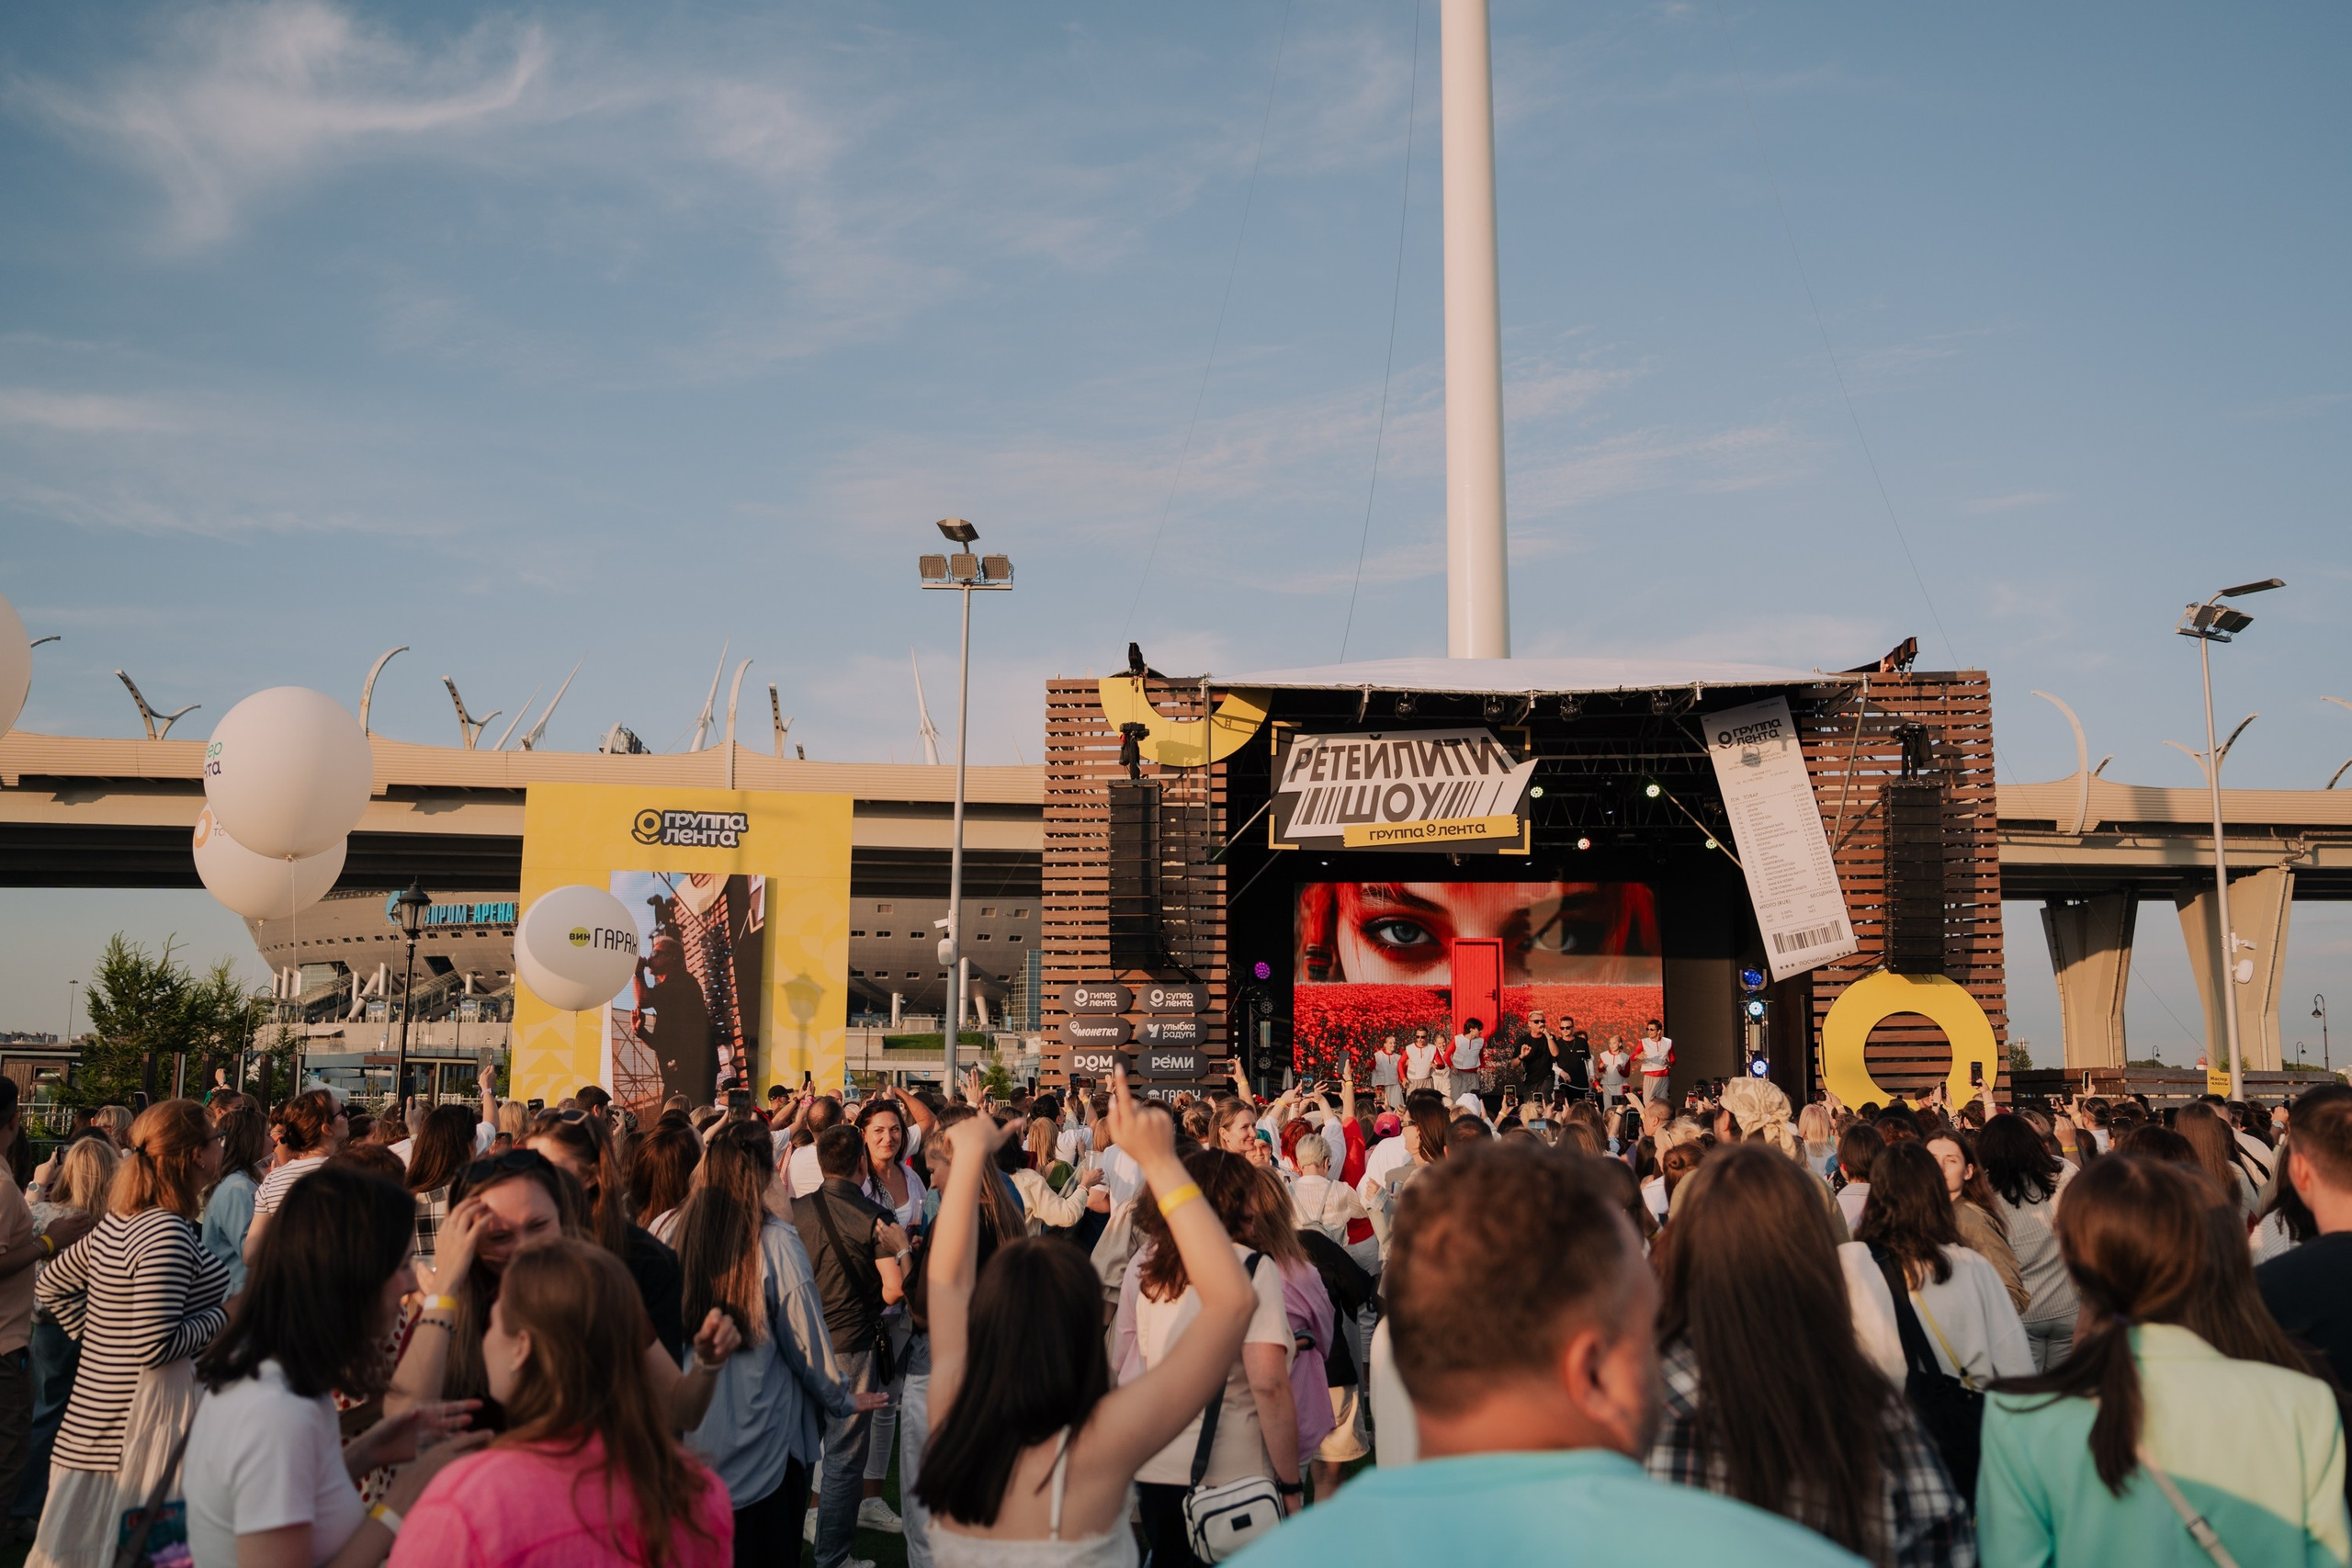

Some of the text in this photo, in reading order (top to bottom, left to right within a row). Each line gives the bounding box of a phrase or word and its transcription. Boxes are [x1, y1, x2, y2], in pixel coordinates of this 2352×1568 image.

[1733, 718, 1782, 738] группа
[1736, 728, 1780, 747] лента
[664, 812, 747, 830] группа
[663, 828, 737, 846] лента
[1369, 823, 1487, 840] группа лента
[424, 902, 514, 924] ЗПРОМ АРЕНА
[1799, 954, 1831, 966] ПОСЧИТАНО
[1090, 992, 1117, 1000] гипер
[1166, 992, 1193, 1000] супер
[1077, 1027, 1119, 1036] монетка
[1162, 1021, 1196, 1031] улыбка
[1162, 1031, 1196, 1039] радуги
